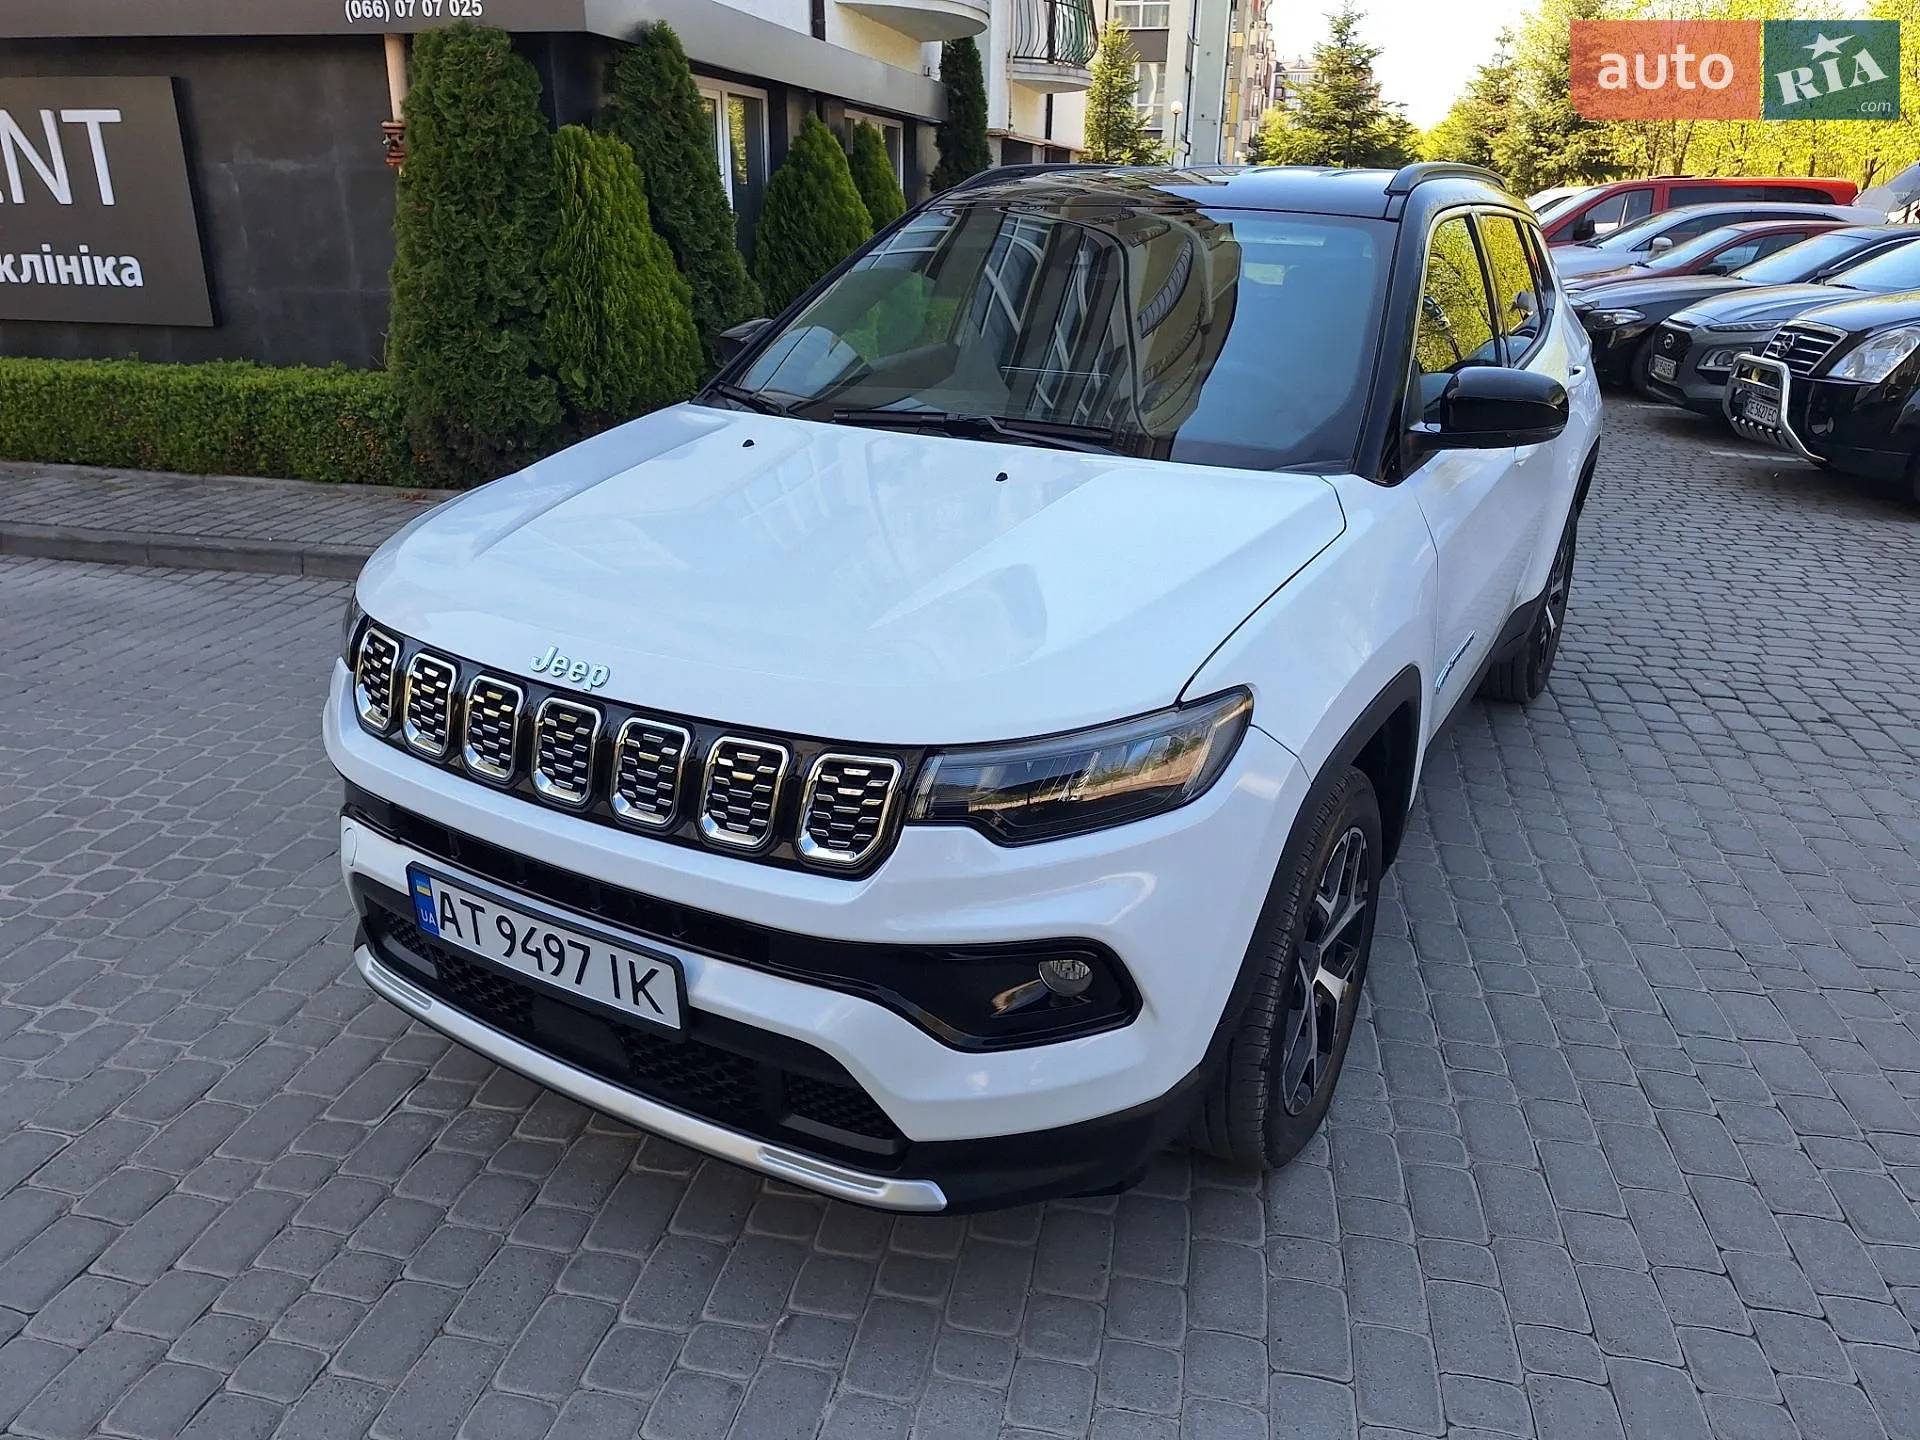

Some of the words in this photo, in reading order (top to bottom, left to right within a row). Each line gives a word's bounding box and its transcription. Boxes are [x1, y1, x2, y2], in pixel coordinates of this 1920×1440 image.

[344, 0, 390, 23] (066)
[394, 0, 416, 17] 07
[422, 0, 442, 17] 07
[449, 0, 483, 17] 025
[0, 109, 122, 206] NT
[530, 645, 611, 692] Jeep
[421, 908, 437, 926] UA
[439, 890, 485, 946] AT
[495, 914, 591, 985] 9497
[609, 953, 665, 1015] IK
